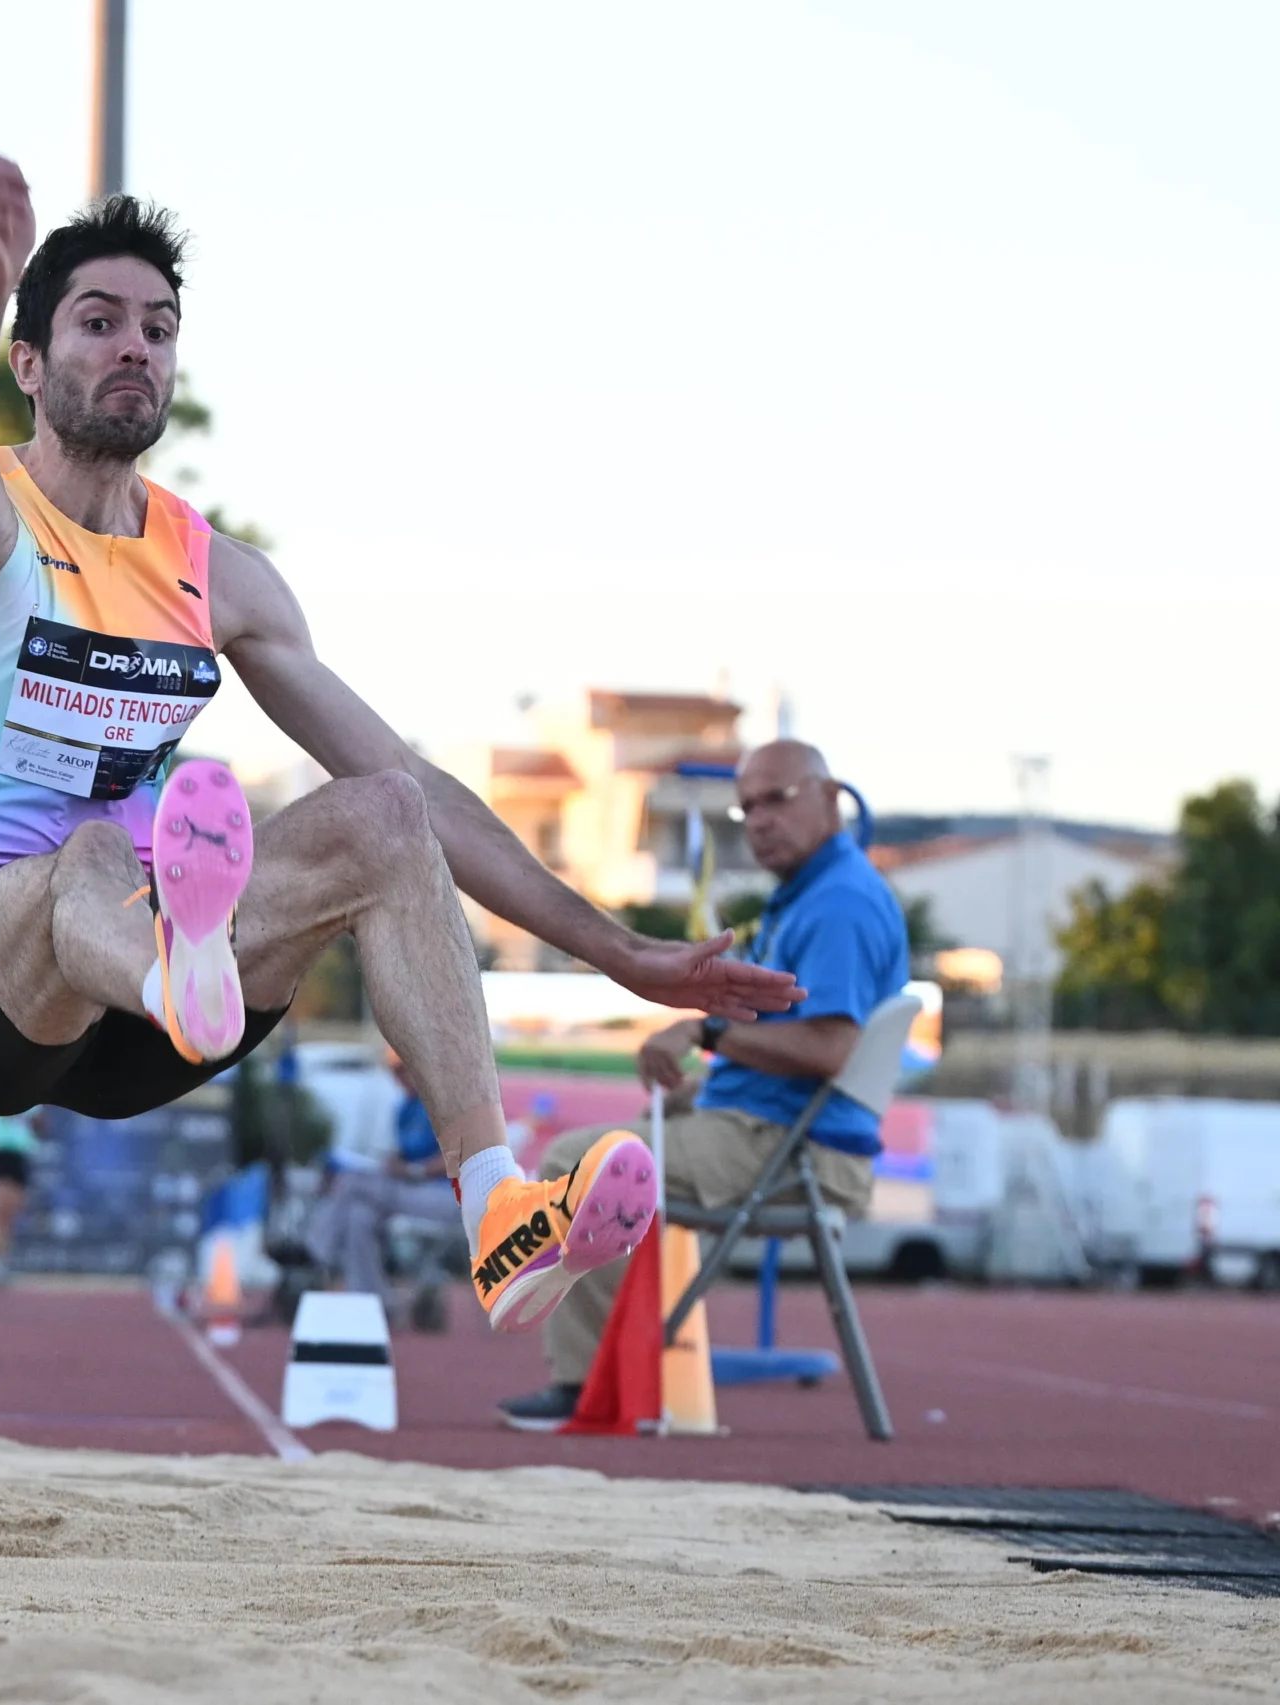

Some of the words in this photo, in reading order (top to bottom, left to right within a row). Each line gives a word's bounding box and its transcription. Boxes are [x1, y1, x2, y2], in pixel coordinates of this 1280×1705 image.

[20, 678, 115, 719] MILTIADIS
[104, 725, 135, 742] GRE
[473, 1209, 552, 1300] NITRO
